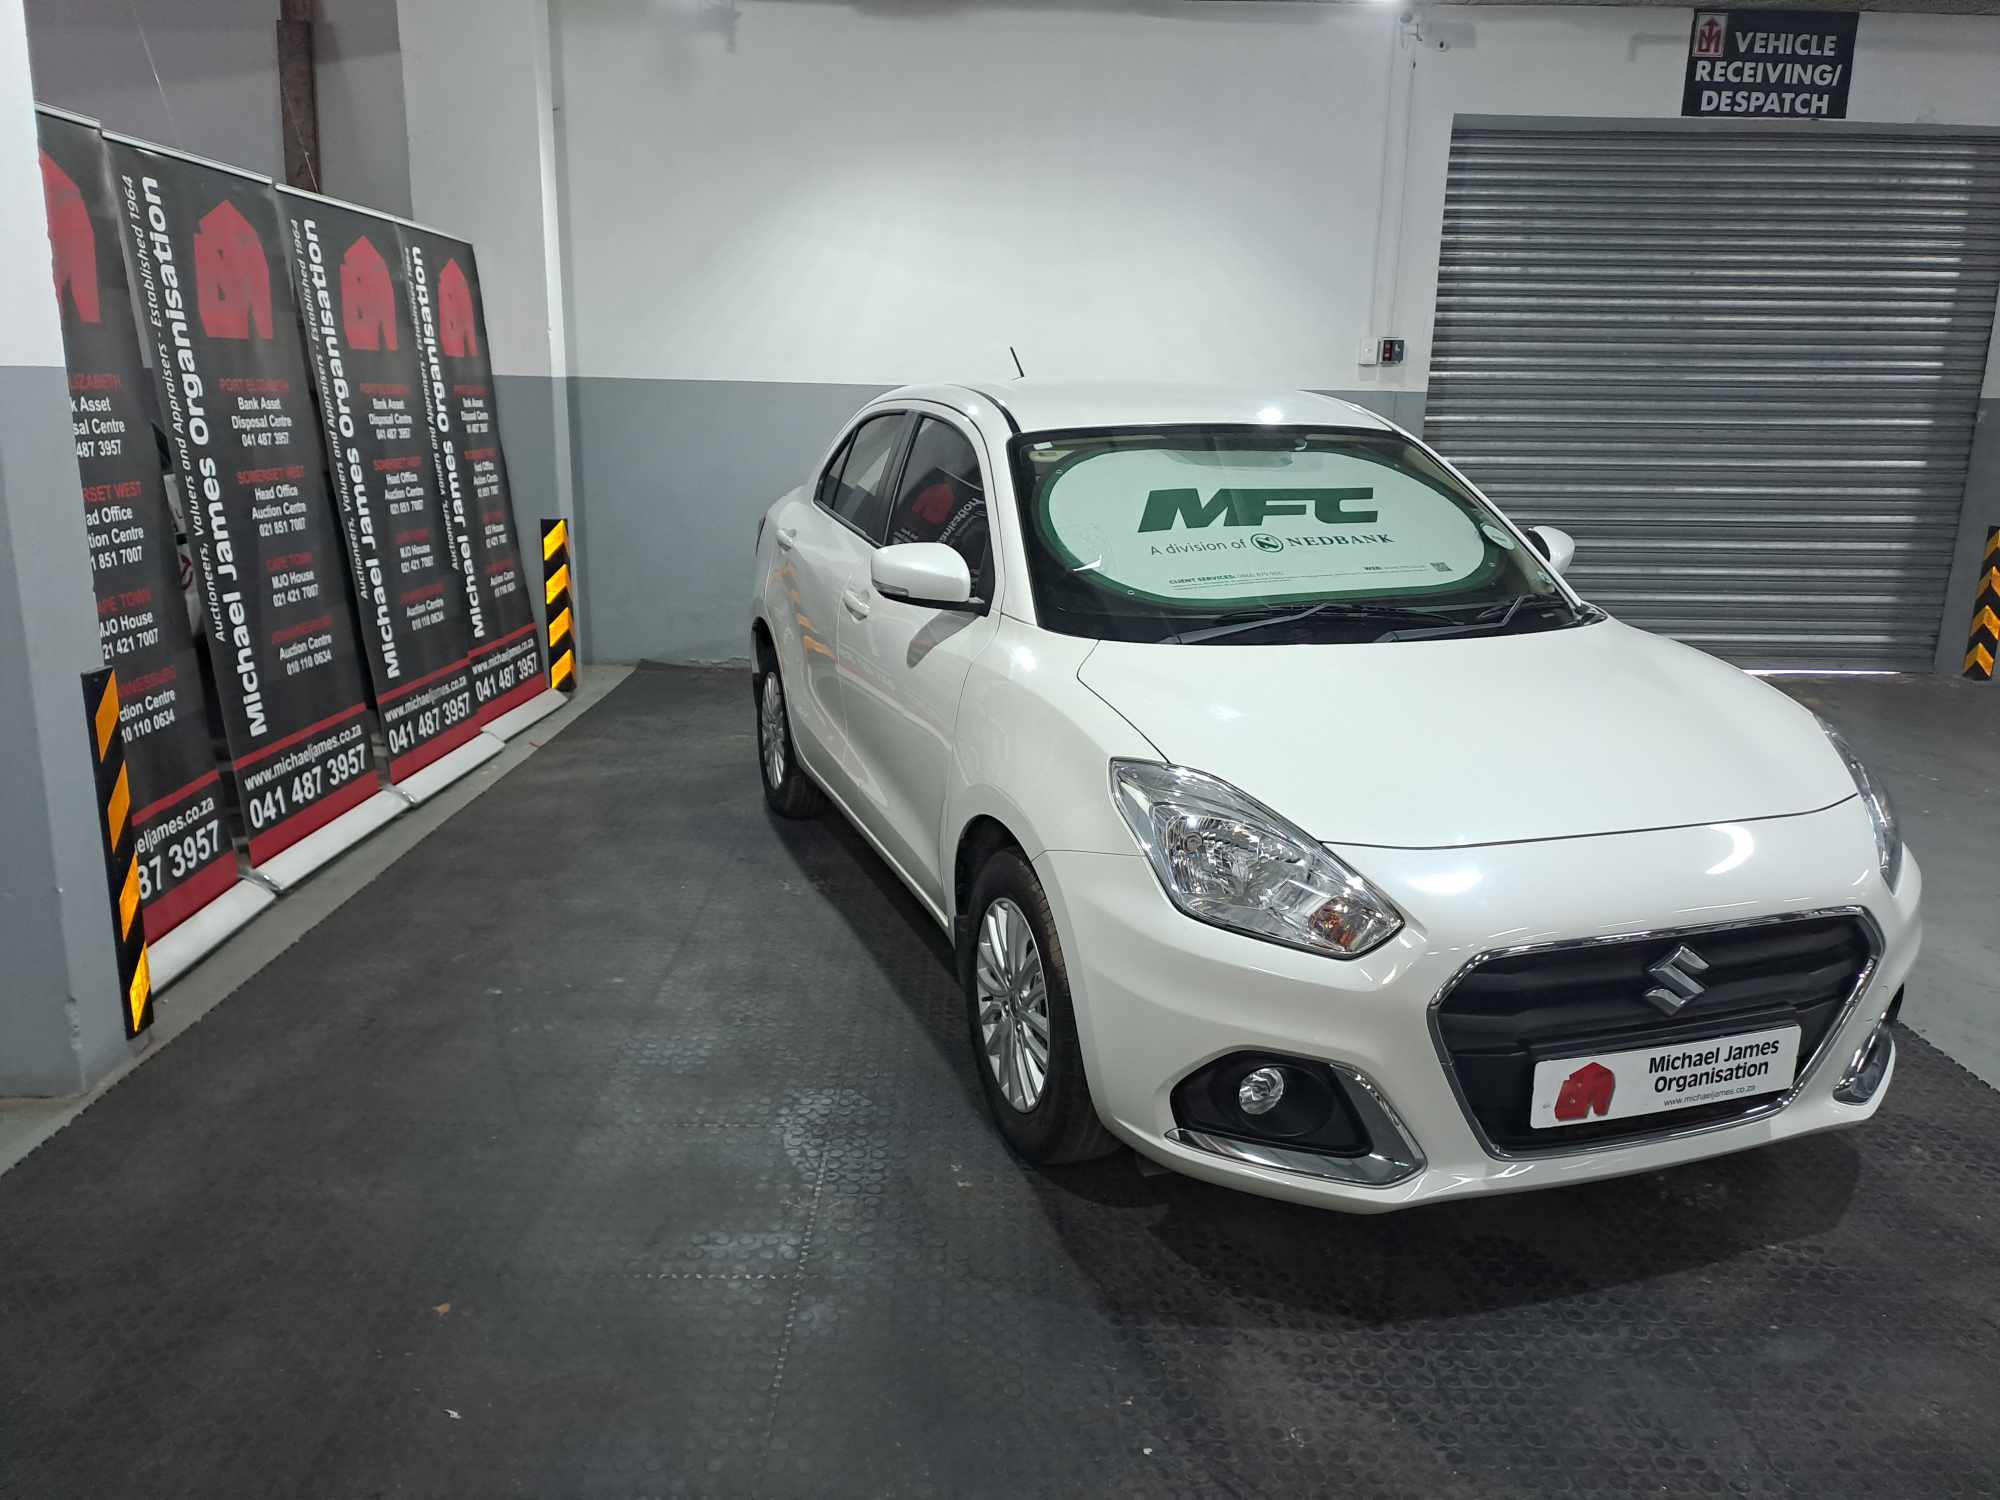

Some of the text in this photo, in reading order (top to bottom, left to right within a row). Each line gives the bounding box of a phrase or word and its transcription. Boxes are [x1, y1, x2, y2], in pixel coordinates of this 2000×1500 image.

[1735, 31, 1838, 57] VEHICLE
[1694, 60, 1842, 87] RECEIVING/
[1700, 90, 1830, 115] DESPATCH
[121, 174, 143, 221] 1964
[290, 218, 304, 256] 1964
[133, 223, 164, 329] Established
[296, 258, 320, 342] Established
[80, 396, 112, 412] Asset
[157, 343, 184, 434] Appraisers
[237, 396, 259, 410] Bank
[316, 352, 336, 428] Appraisers
[73, 418, 126, 436] sal Centre
[231, 414, 293, 431] Disposal Centre
[76, 439, 122, 458] 487 3957
[174, 437, 192, 470] and
[241, 433, 256, 447] 041
[257, 433, 272, 446] 487
[303, 219, 401, 679] Michael James Organisation
[328, 429, 342, 458] and
[411, 246, 486, 639] Michael James Organisation
[141, 176, 268, 738] Michael James Organisation
[254, 484, 299, 501] Head Office
[335, 461, 352, 512] Valuers
[86, 505, 134, 526] ad Office
[184, 475, 204, 537] Valuers
[251, 501, 307, 520] Auction Centre
[1137, 487, 1379, 533] MFC
[88, 526, 145, 549] tion Centre
[258, 523, 273, 537] 021
[274, 521, 288, 535] 851
[1150, 545, 1162, 556] A
[1166, 540, 1228, 556] division
[1230, 538, 1247, 550] of
[1285, 533, 1397, 548] NEDBANK
[99, 551, 118, 570] 851
[119, 545, 143, 565] 7007
[199, 542, 226, 643] Auctioneers,
[289, 570, 315, 584] House
[287, 589, 301, 603] 421
[119, 611, 153, 632] House
[102, 627, 159, 660] 21 421 7007
[279, 634, 332, 661] Auction Centre
[475, 651, 538, 702] 041 487 3957
[119, 688, 176, 723] ction Centre
[121, 708, 176, 744] 10 110 0634
[388, 691, 471, 754] 041 487 3957
[244, 724, 362, 791] www.michaeljames.co.za
[249, 743, 366, 829] 041 487 3957
[138, 819, 219, 901] 87 3957
[1648, 1039, 1780, 1075] Michael James
[1653, 1059, 1769, 1095] Organisation
[1663, 1084, 1757, 1108] www.michaeljames.co.za
